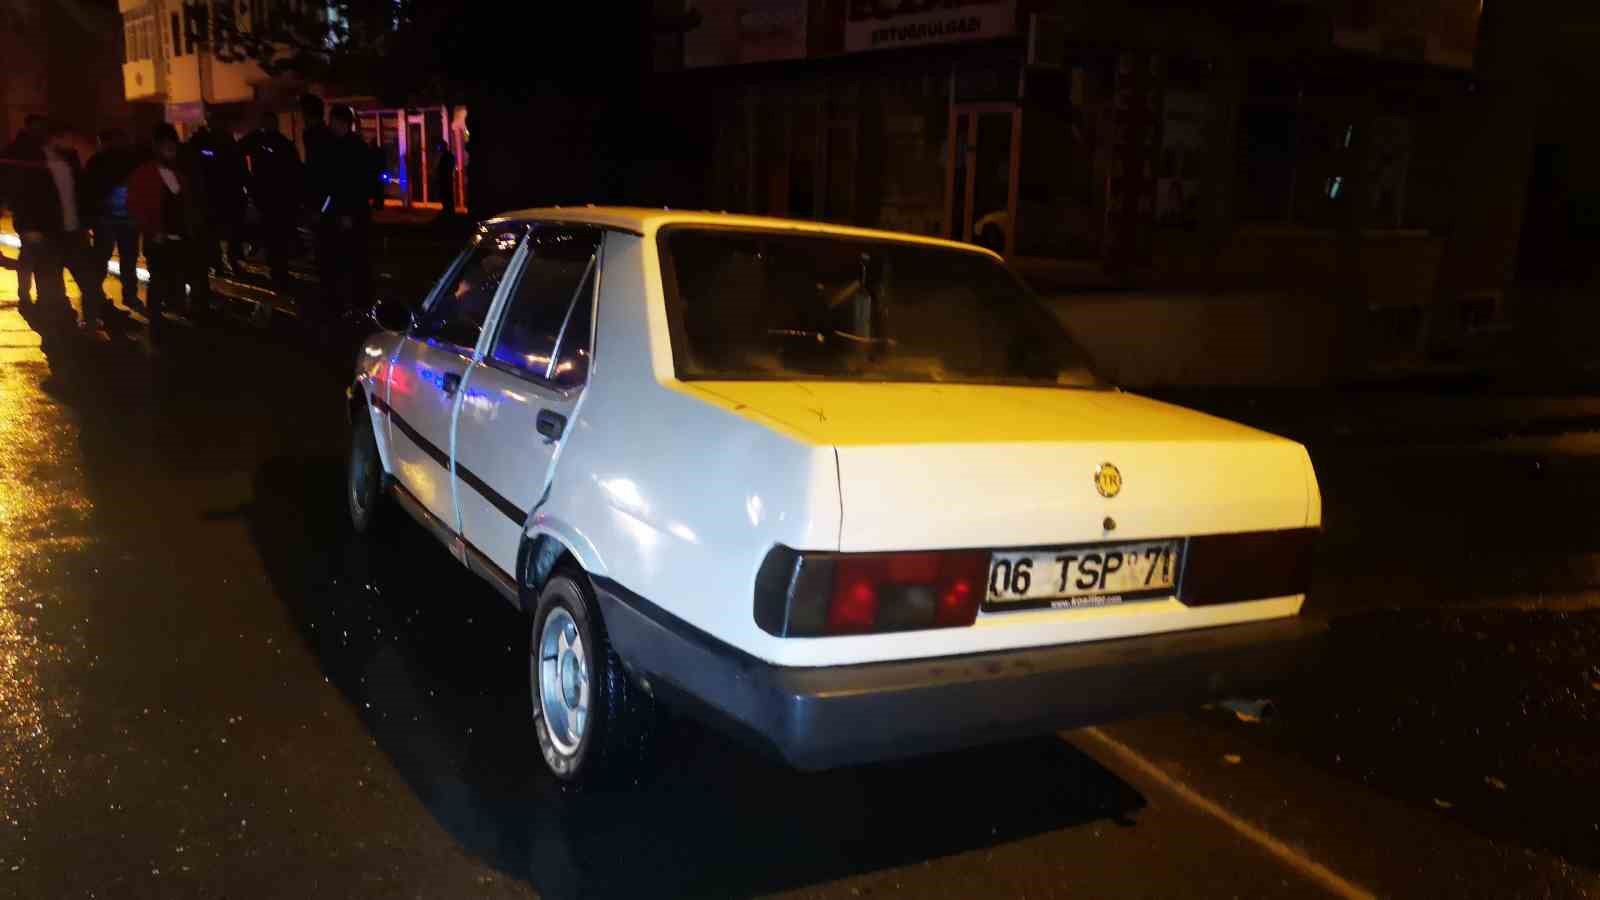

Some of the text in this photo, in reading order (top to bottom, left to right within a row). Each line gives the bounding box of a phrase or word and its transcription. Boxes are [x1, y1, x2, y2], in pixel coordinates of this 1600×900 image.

[989, 546, 1171, 597] 06 TSP 71
